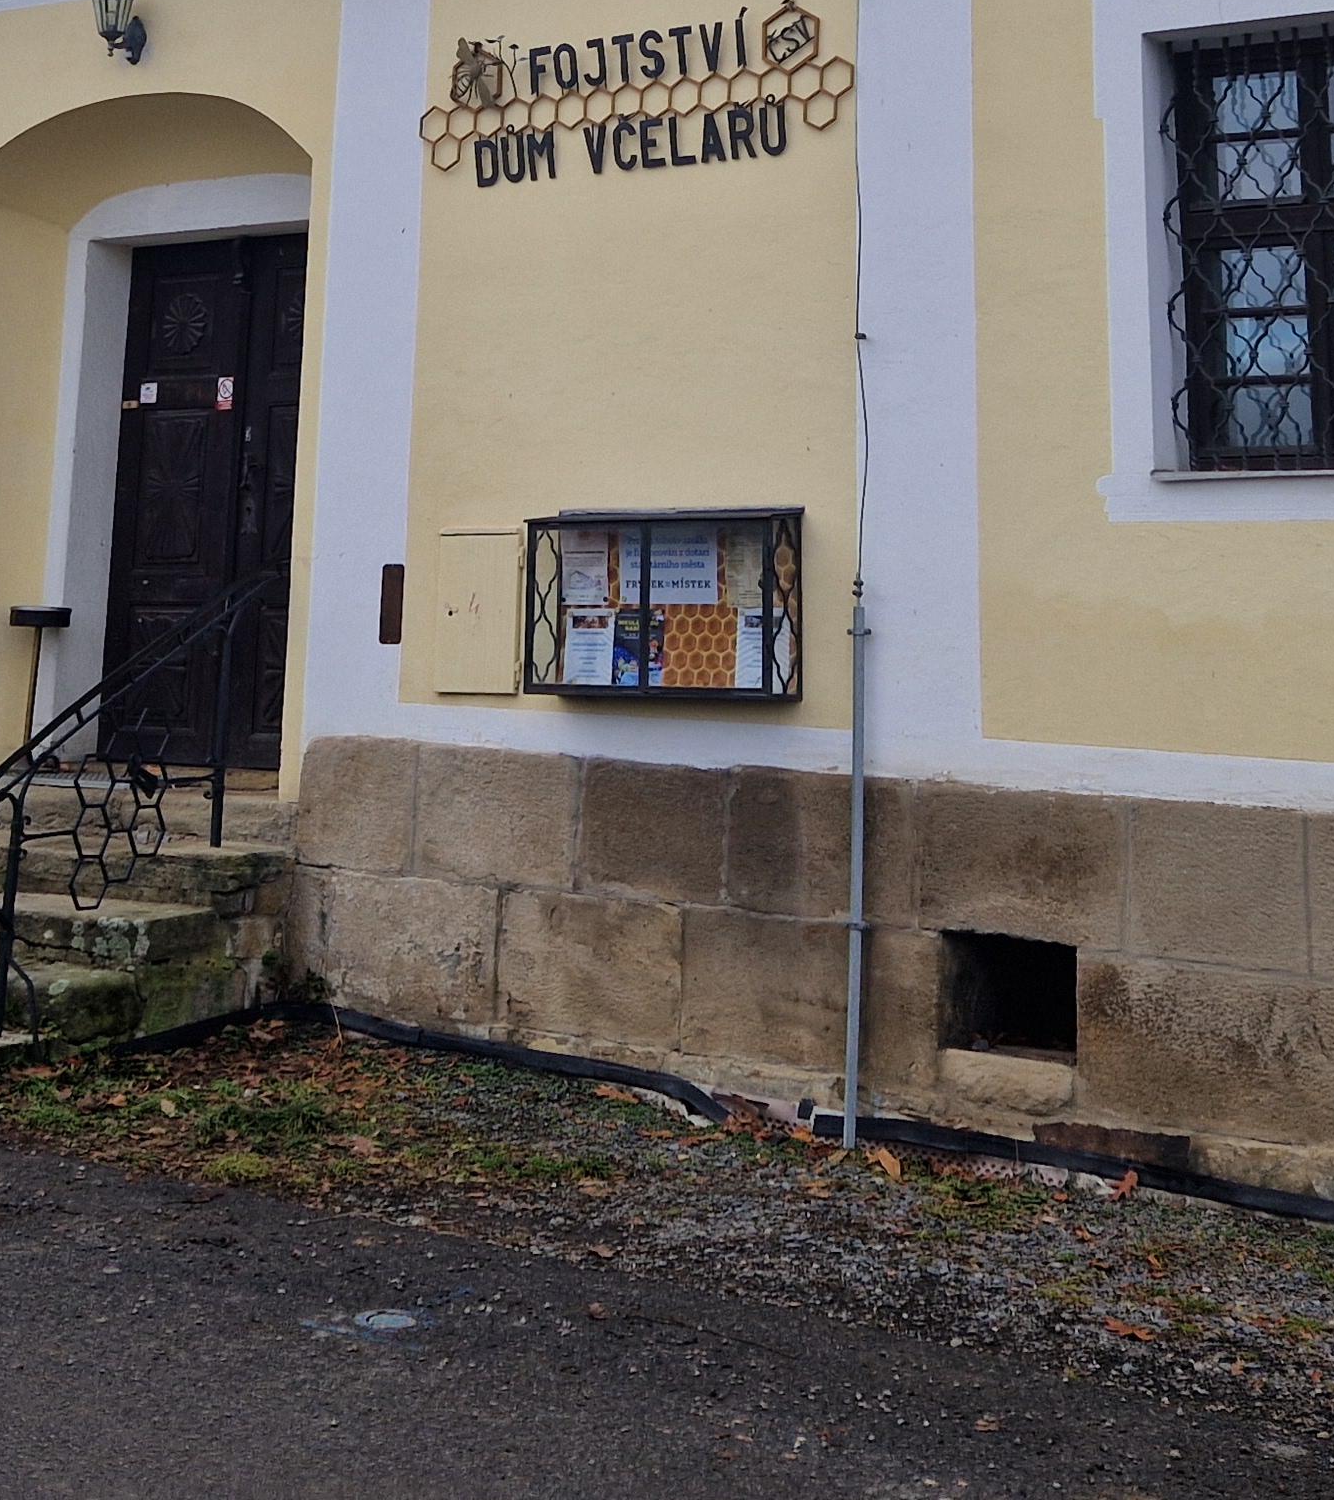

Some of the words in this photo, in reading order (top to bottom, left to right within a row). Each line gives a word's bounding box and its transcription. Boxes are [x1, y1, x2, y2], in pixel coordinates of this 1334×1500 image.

[529, 7, 748, 96] FOJTSTVÍ
[474, 124, 556, 187] DŮM
[583, 94, 786, 174] VČELAŘŮ
